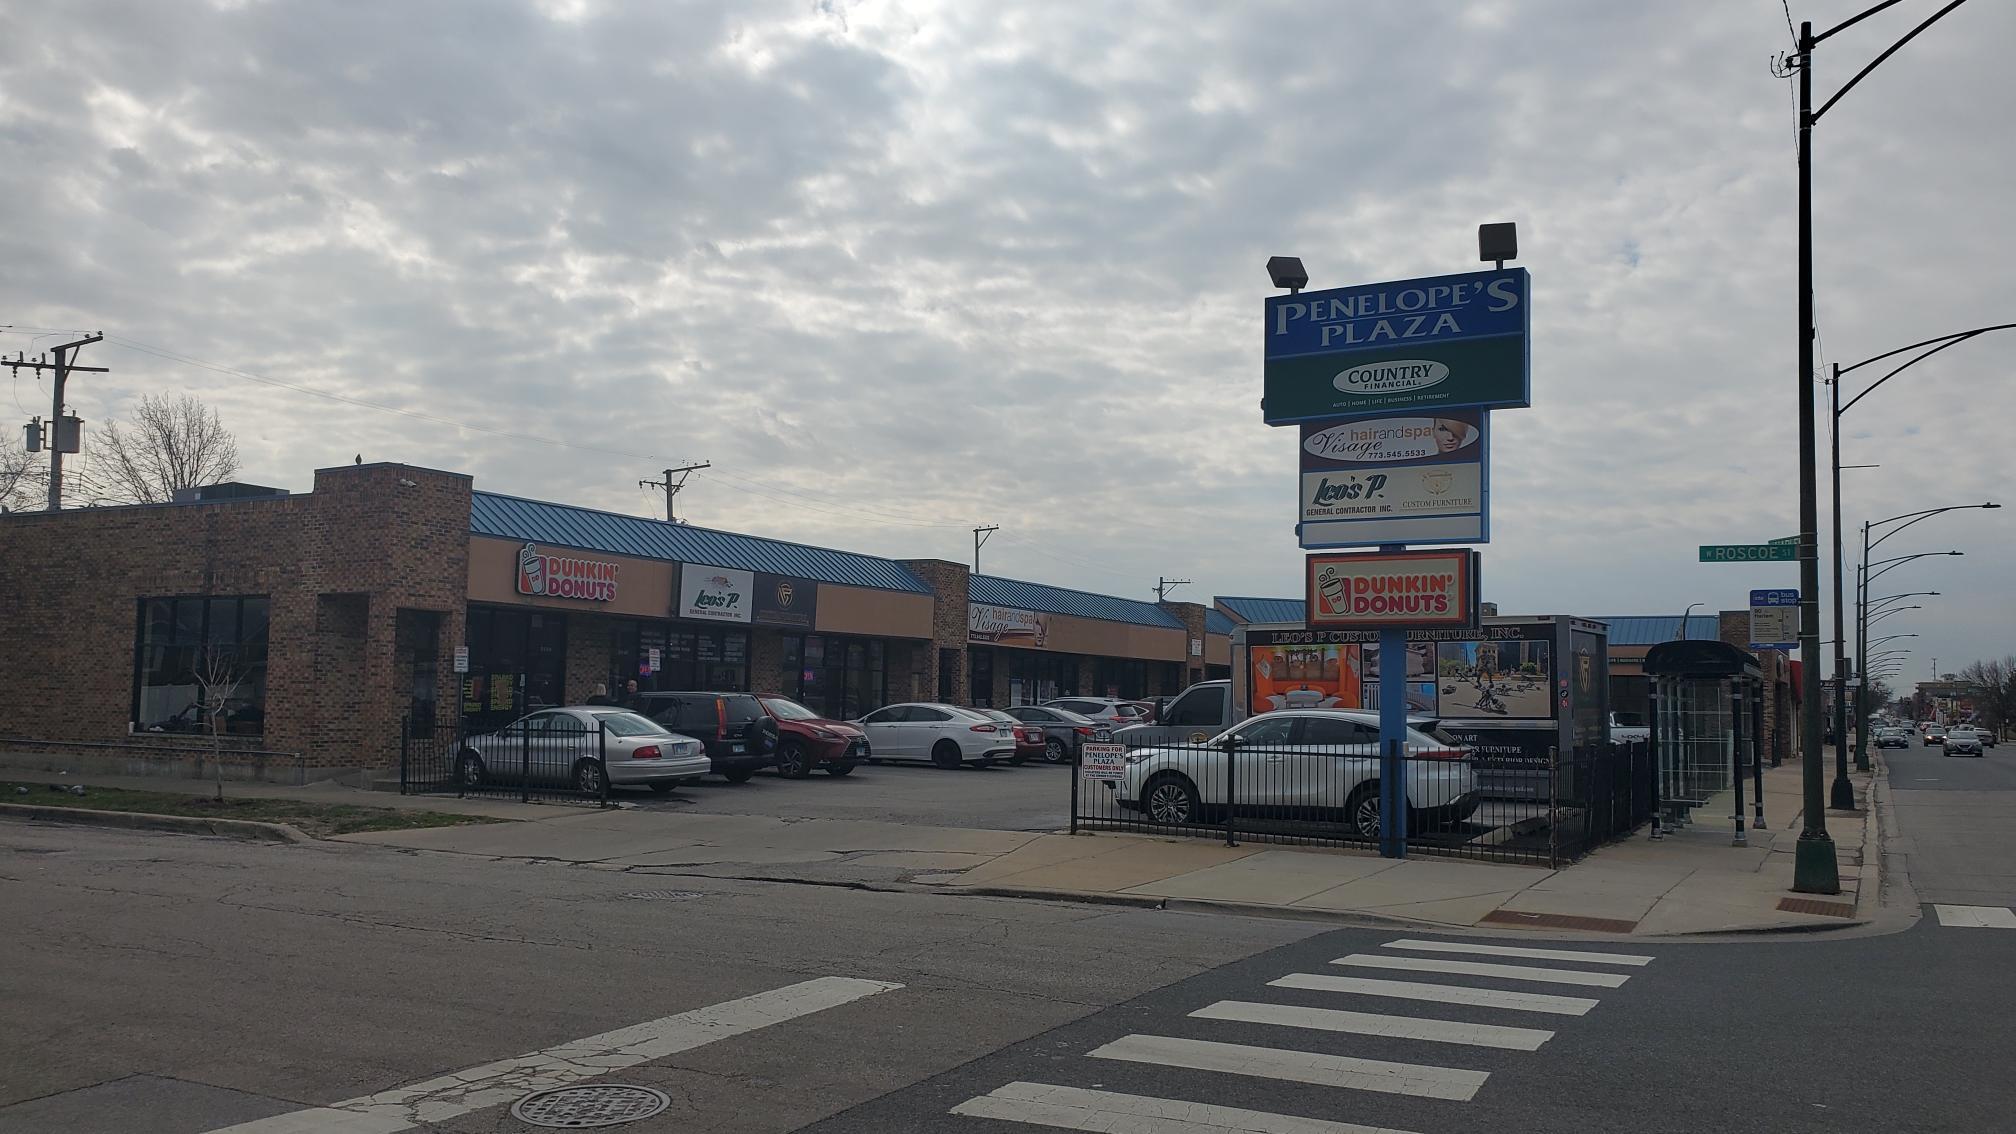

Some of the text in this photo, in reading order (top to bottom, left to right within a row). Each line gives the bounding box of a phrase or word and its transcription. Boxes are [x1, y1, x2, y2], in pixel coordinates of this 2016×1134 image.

[1275, 278, 1519, 336] PENELOPE'S
[1320, 312, 1463, 347] PLAZA
[1347, 364, 1433, 385] COUNTRY
[1364, 380, 1418, 390] FINANCIAL
[1312, 432, 1383, 460] Visage
[1368, 449, 1426, 459] 773.545.5533
[1306, 504, 1393, 516] GENERAL CONTRACTOR INC.
[1402, 498, 1473, 508] CUSTOM FURNITURE
[1715, 547, 1779, 560] ROSCOE
[549, 557, 619, 581] DUNKIN'
[548, 577, 616, 601] DONUTS
[1354, 574, 1453, 594] DUNKIN'
[1354, 594, 1448, 613] DONUTS
[971, 606, 1009, 642] Visage
[1272, 627, 1525, 644] LEO'S P CUSTO URNITURE, INC.
[1464, 734, 1478, 742] ART
